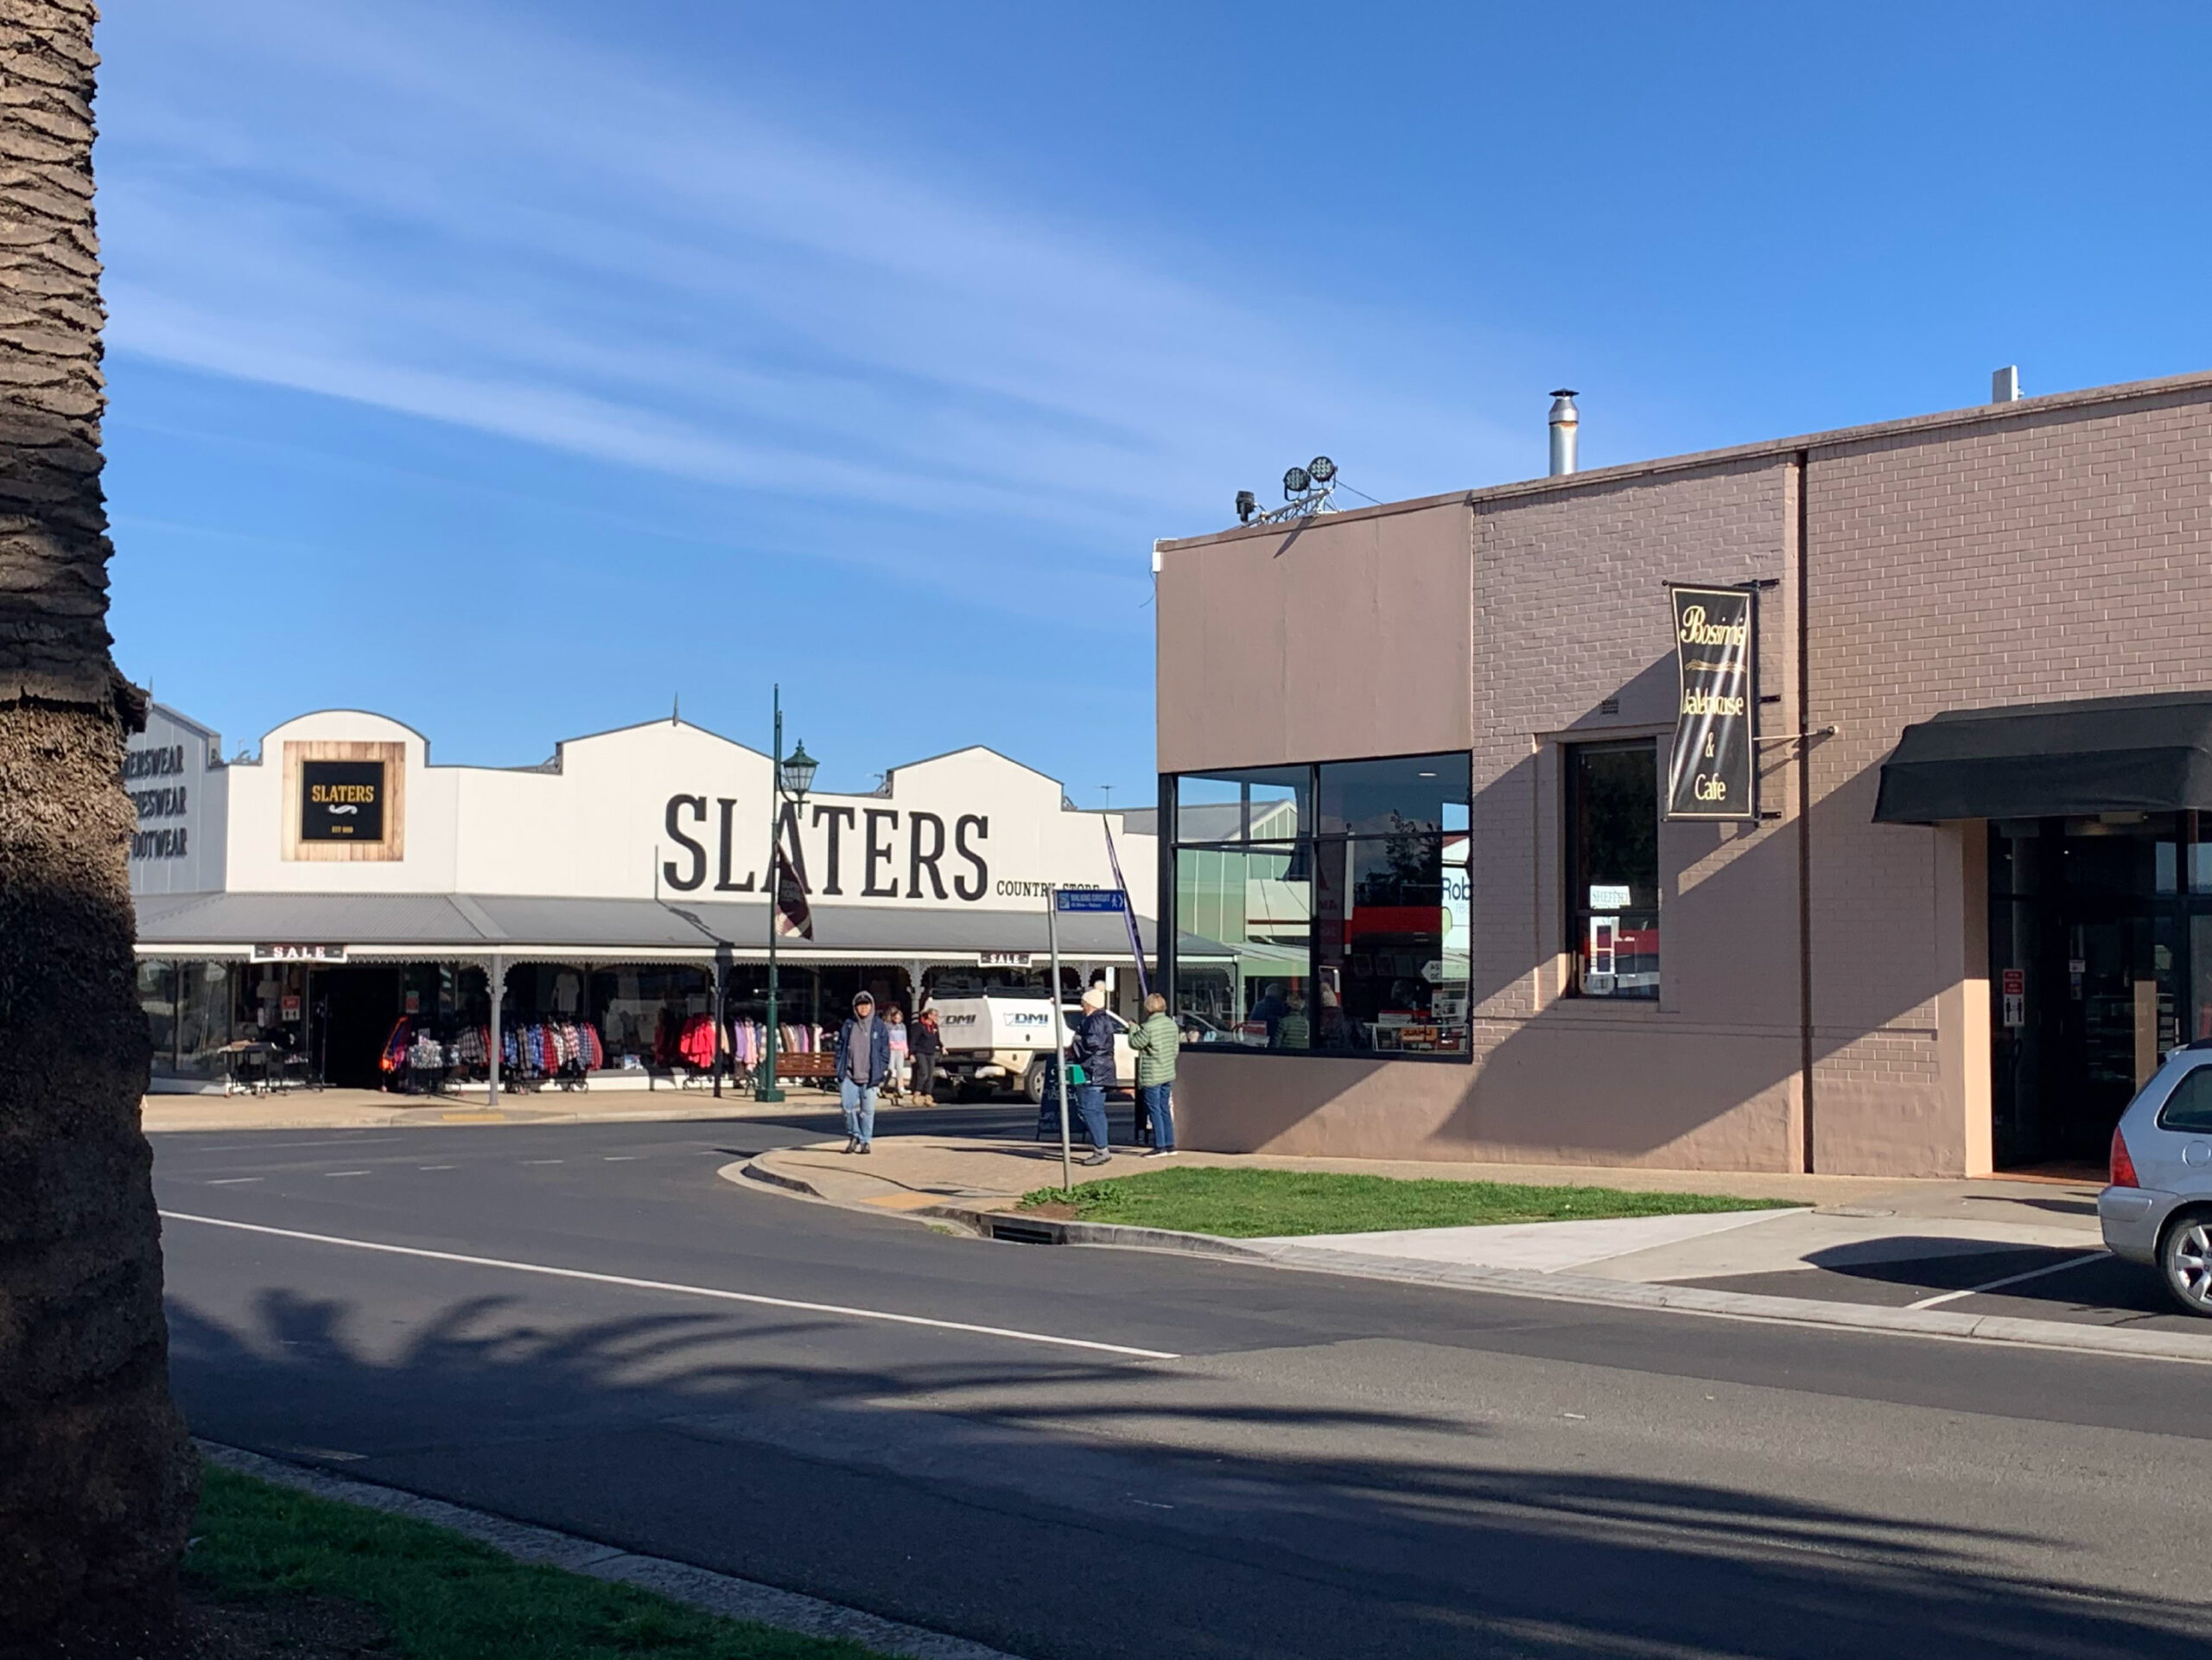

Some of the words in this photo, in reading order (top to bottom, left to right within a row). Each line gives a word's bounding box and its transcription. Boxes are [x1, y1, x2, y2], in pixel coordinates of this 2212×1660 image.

[1705, 732, 1715, 757] &
[312, 785, 374, 803] SLATERS
[1694, 773, 1726, 800] Cafe
[664, 793, 988, 901] SLATERS
[273, 945, 326, 958] SALE
[990, 953, 1020, 964] SALE
[946, 1014, 976, 1025] DMI
[1014, 1013, 1048, 1024] DMI
